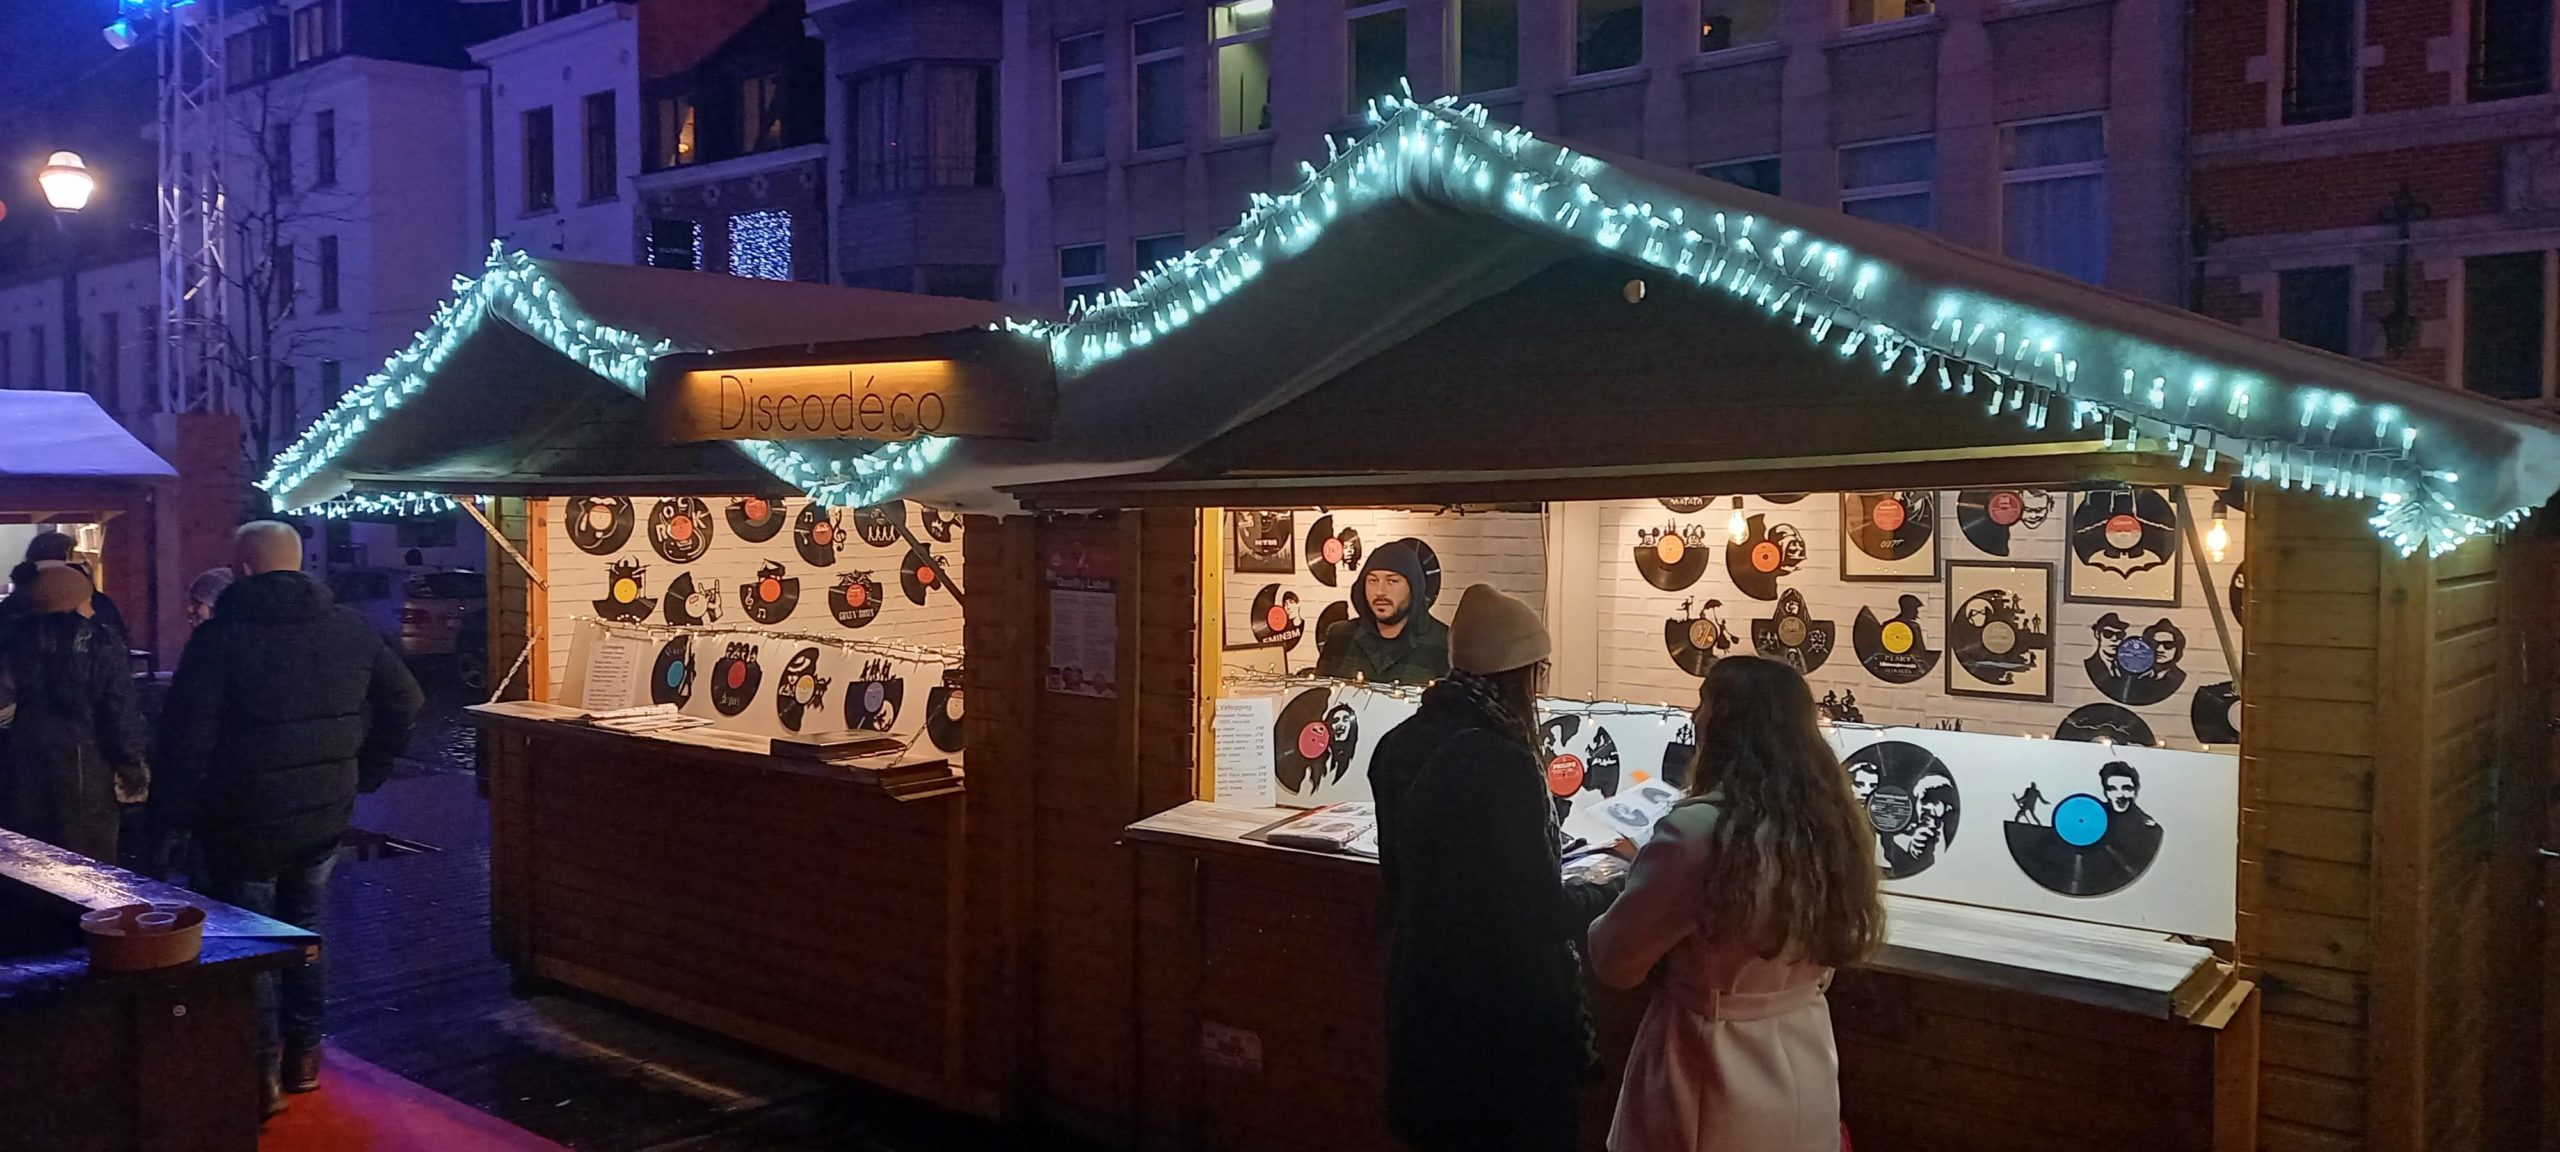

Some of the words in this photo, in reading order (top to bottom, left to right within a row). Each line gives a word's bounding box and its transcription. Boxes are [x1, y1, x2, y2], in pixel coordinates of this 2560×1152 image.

[719, 370, 945, 432] Discodéco
[1262, 628, 1301, 643] EMINEM
[1552, 761, 1577, 770] PHILIPS
